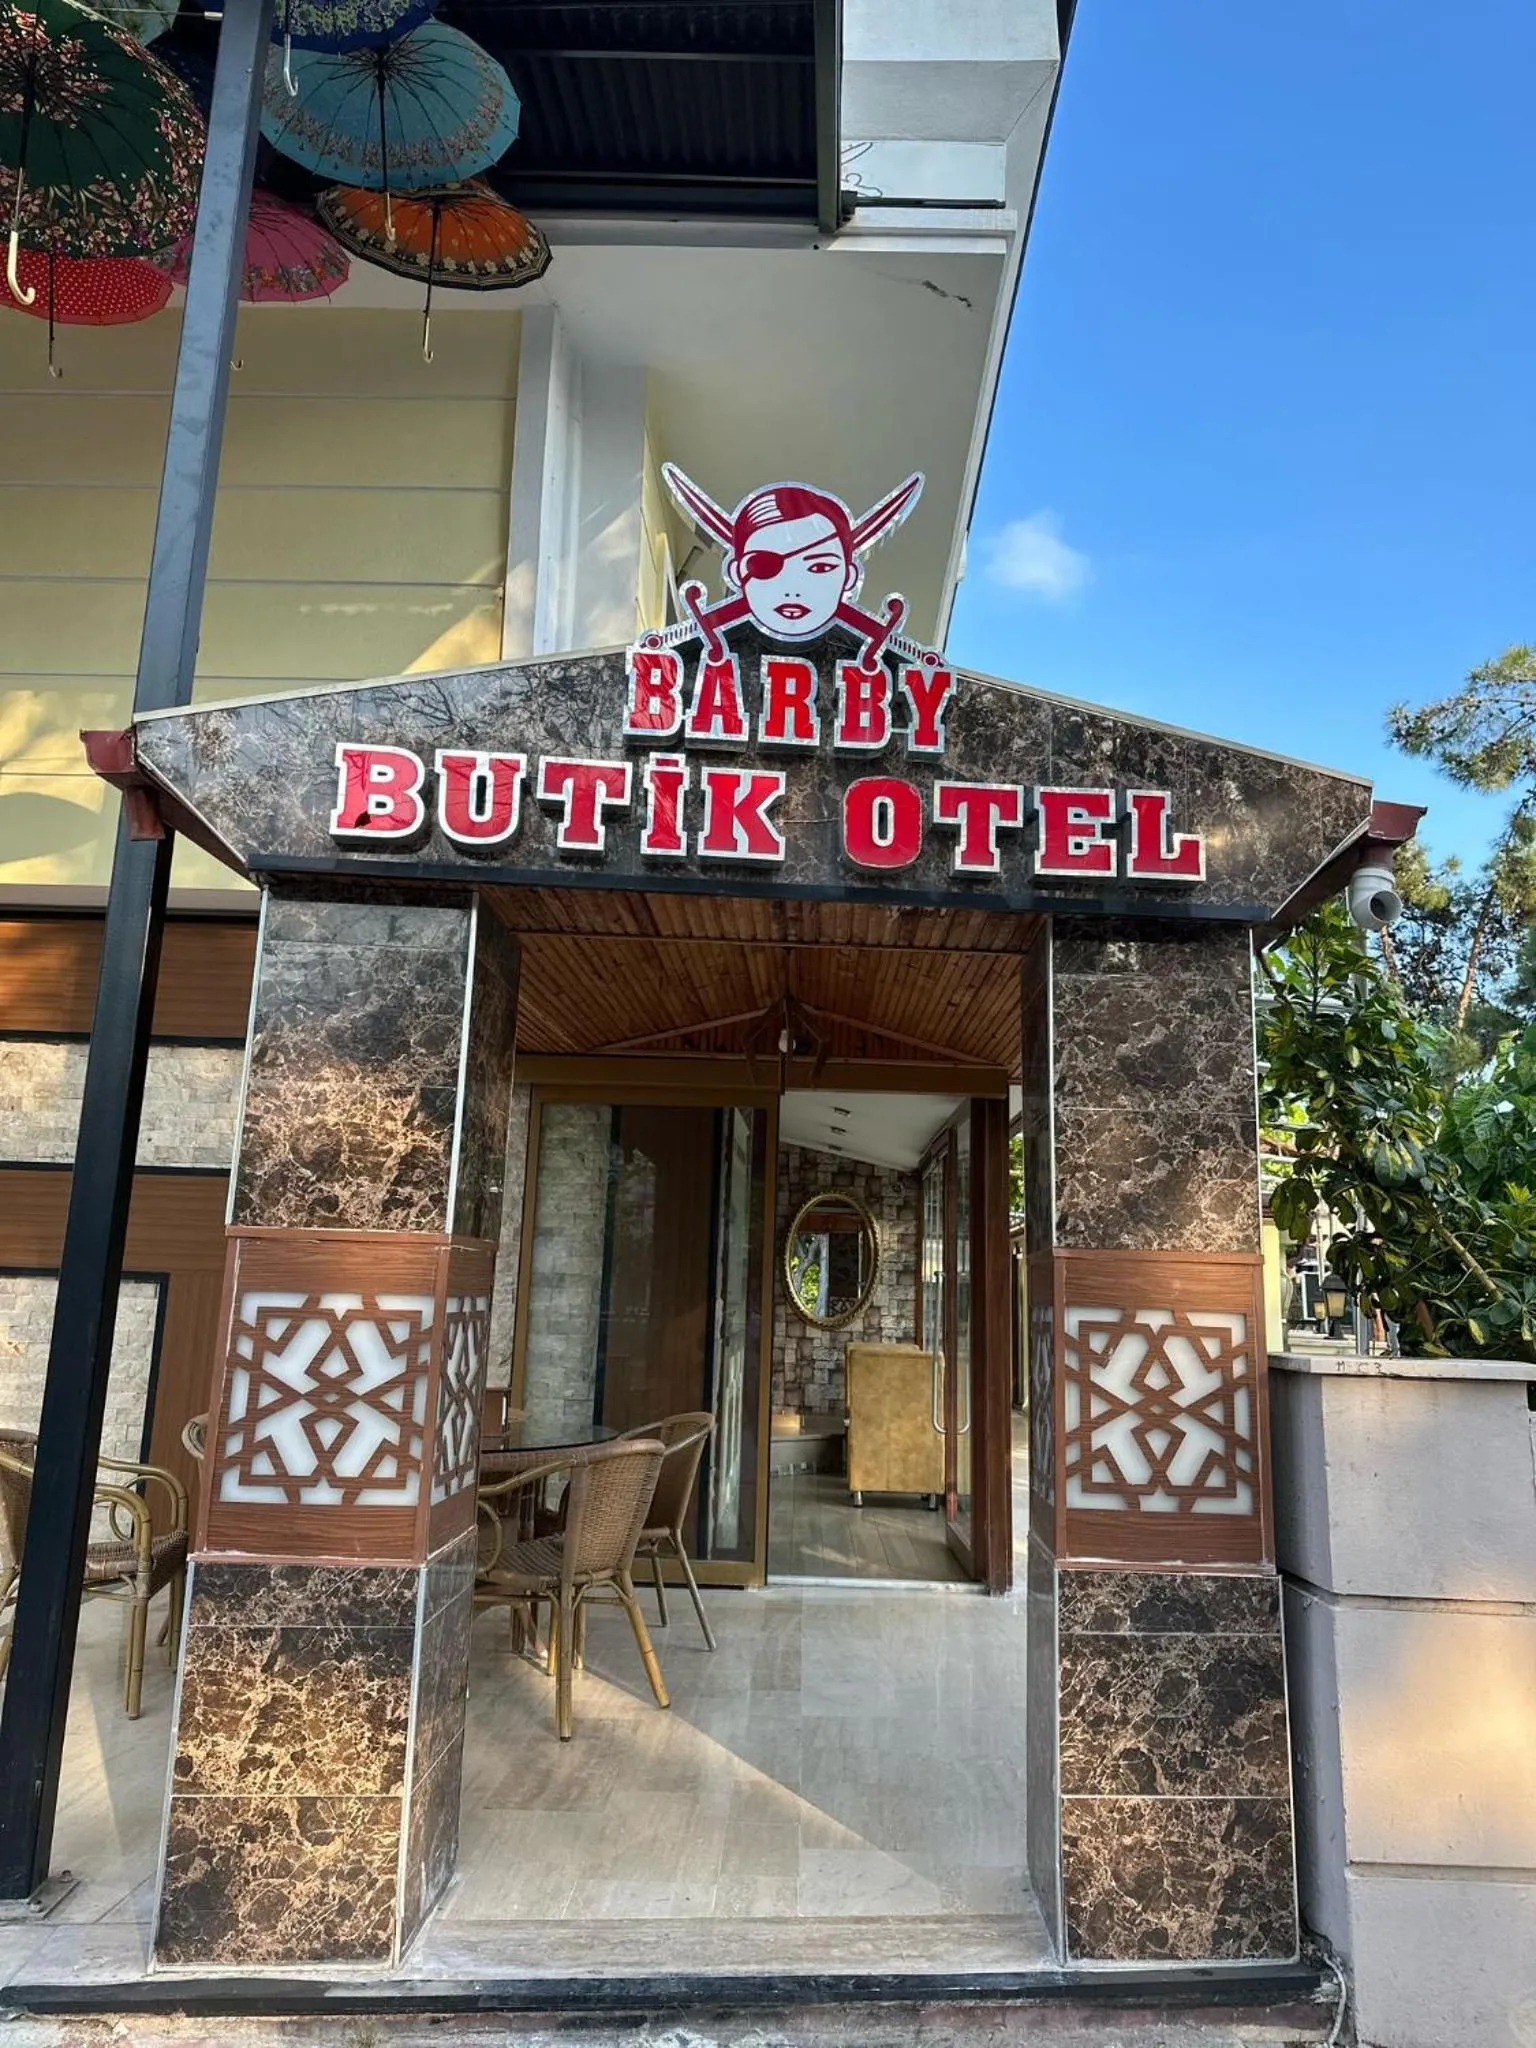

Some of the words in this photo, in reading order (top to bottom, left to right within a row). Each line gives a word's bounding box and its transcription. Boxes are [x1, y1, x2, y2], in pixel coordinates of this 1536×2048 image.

[624, 647, 957, 756] BARBY
[329, 742, 787, 862] BUTİK
[843, 776, 1207, 882] OTEL
